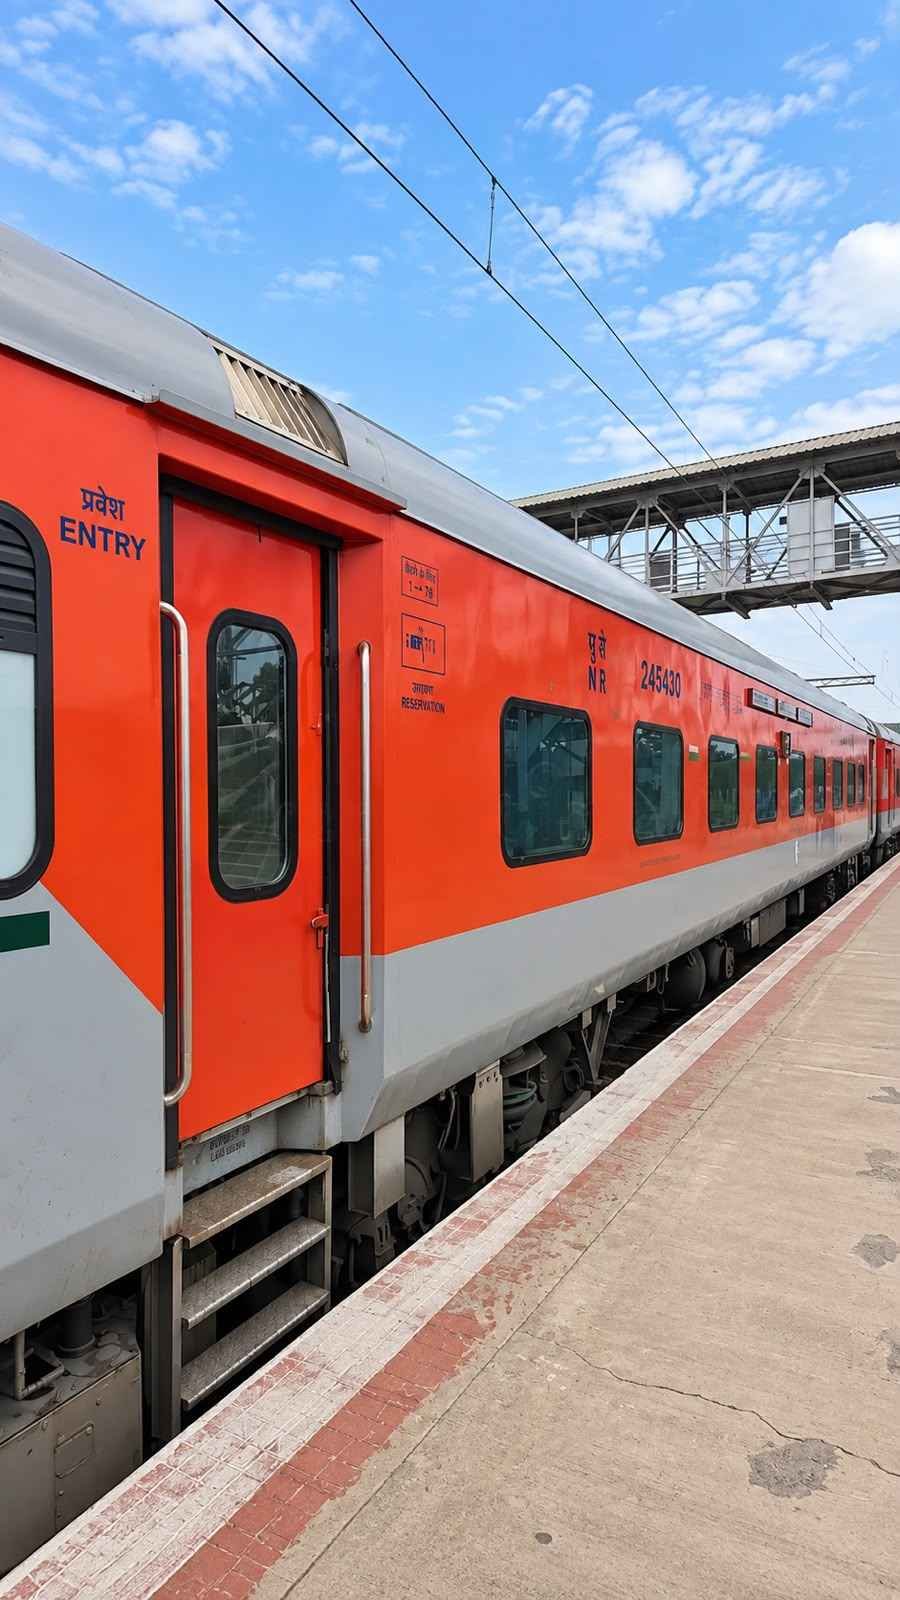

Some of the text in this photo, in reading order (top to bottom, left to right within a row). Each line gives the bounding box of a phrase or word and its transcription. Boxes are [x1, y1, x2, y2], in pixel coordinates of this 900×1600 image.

[80, 485, 125, 521] प्रवेश
[60, 515, 146, 561] ENTRY
[641, 660, 681, 699] 245430
[401, 696, 446, 714] RESERVATION
